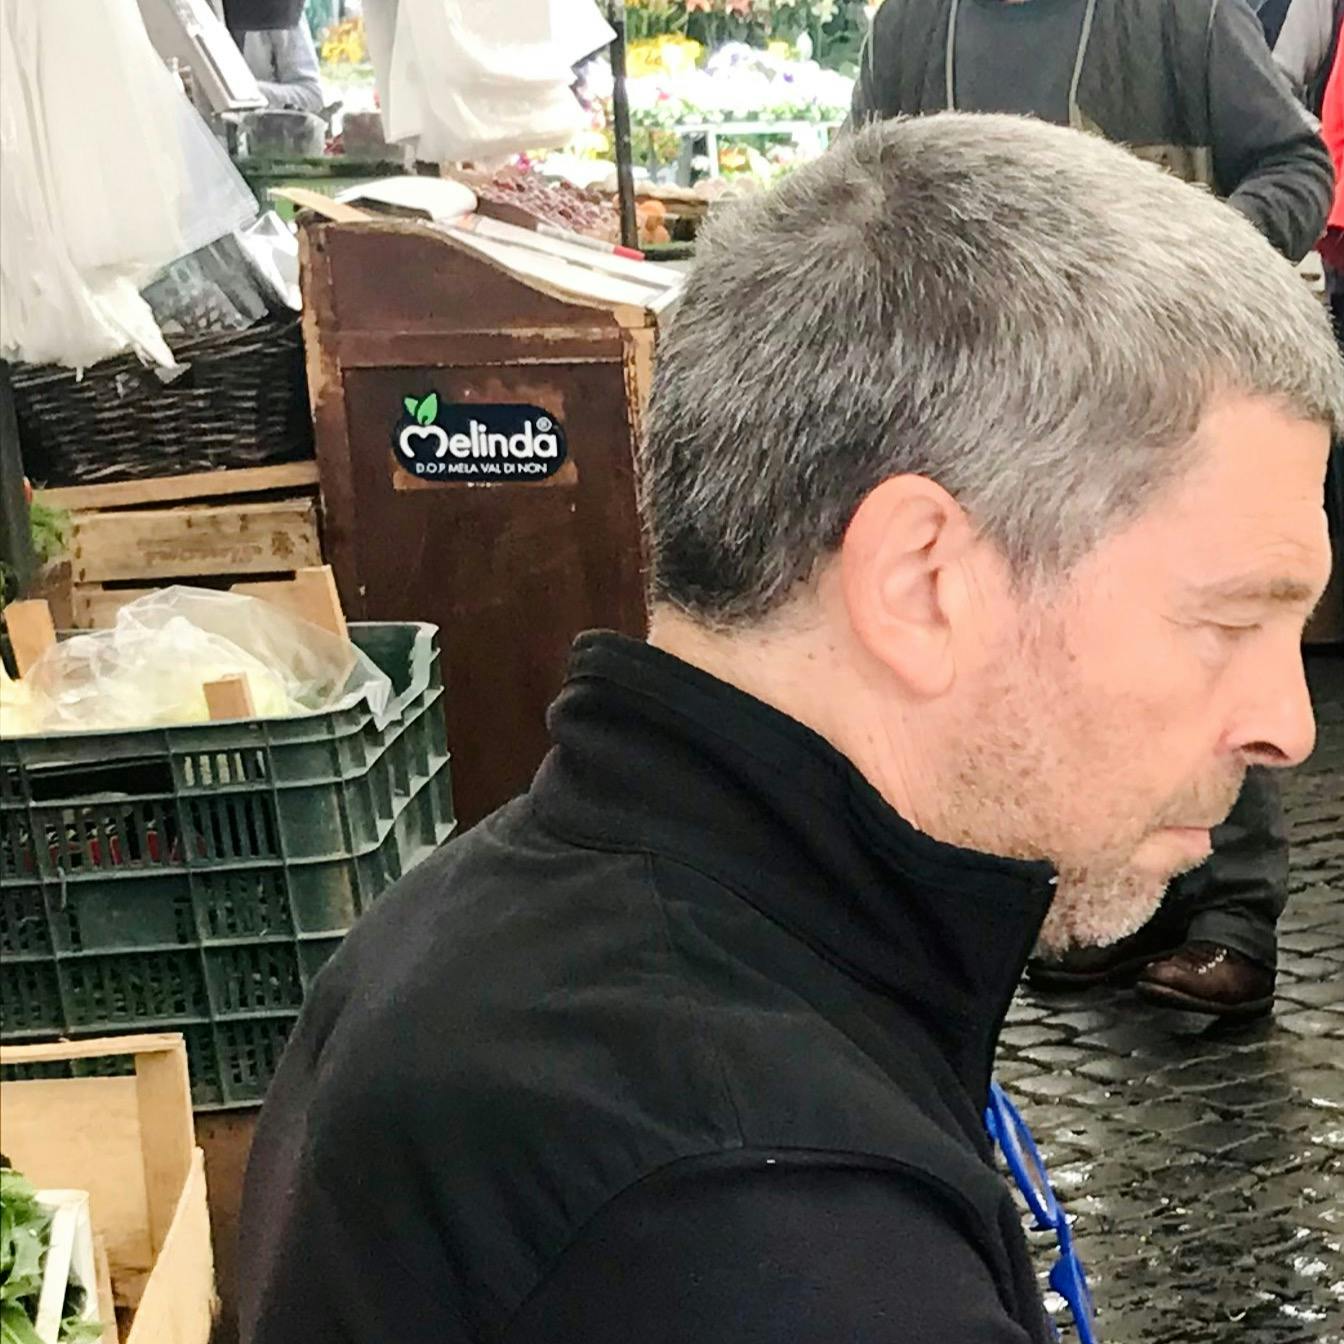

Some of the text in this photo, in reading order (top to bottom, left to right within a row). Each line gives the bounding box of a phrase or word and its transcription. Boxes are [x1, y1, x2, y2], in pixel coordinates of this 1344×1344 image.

[447, 462, 479, 475] MELA
[480, 462, 502, 475] VAL
[503, 462, 516, 475] DI
[517, 462, 548, 475] NON
